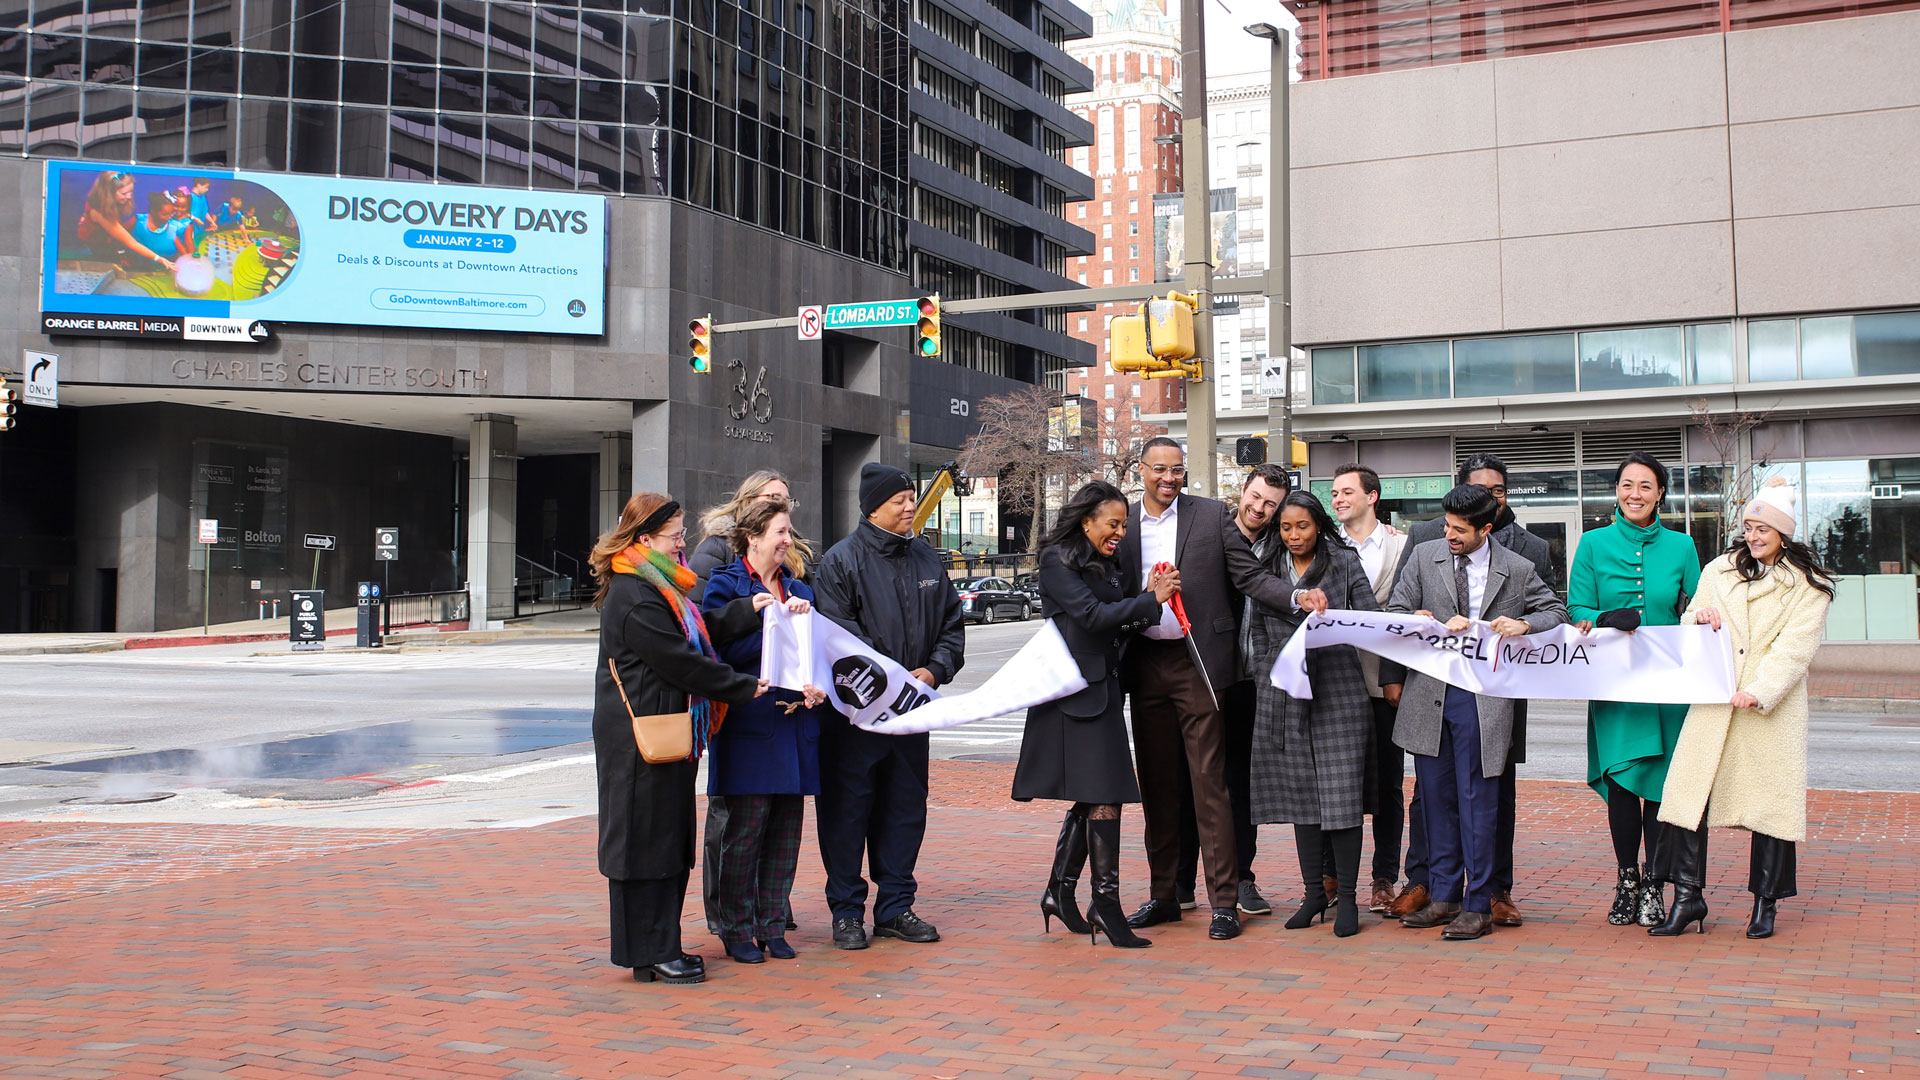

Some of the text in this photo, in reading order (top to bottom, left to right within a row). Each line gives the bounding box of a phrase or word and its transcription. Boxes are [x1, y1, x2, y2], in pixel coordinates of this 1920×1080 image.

[329, 195, 588, 234] DISCOVERY DAYS
[416, 234, 472, 247] JANUARY
[337, 254, 578, 275] Deals & Discounts at Downtown Attractions
[389, 294, 528, 310] GoDowntownBaltimore.com
[831, 306, 914, 325] LOMBARD ST.
[45, 318, 180, 333] ORANGE BARREL MEDIA
[190, 323, 242, 335] DOWNTOWN
[172, 359, 488, 389] CHARLES CENTER SOUTH
[29, 384, 52, 395] ONLY
[727, 359, 773, 424] 36
[951, 398, 969, 417] 20
[1507, 486, 1535, 494] ombard
[245, 530, 281, 543] Bolton
